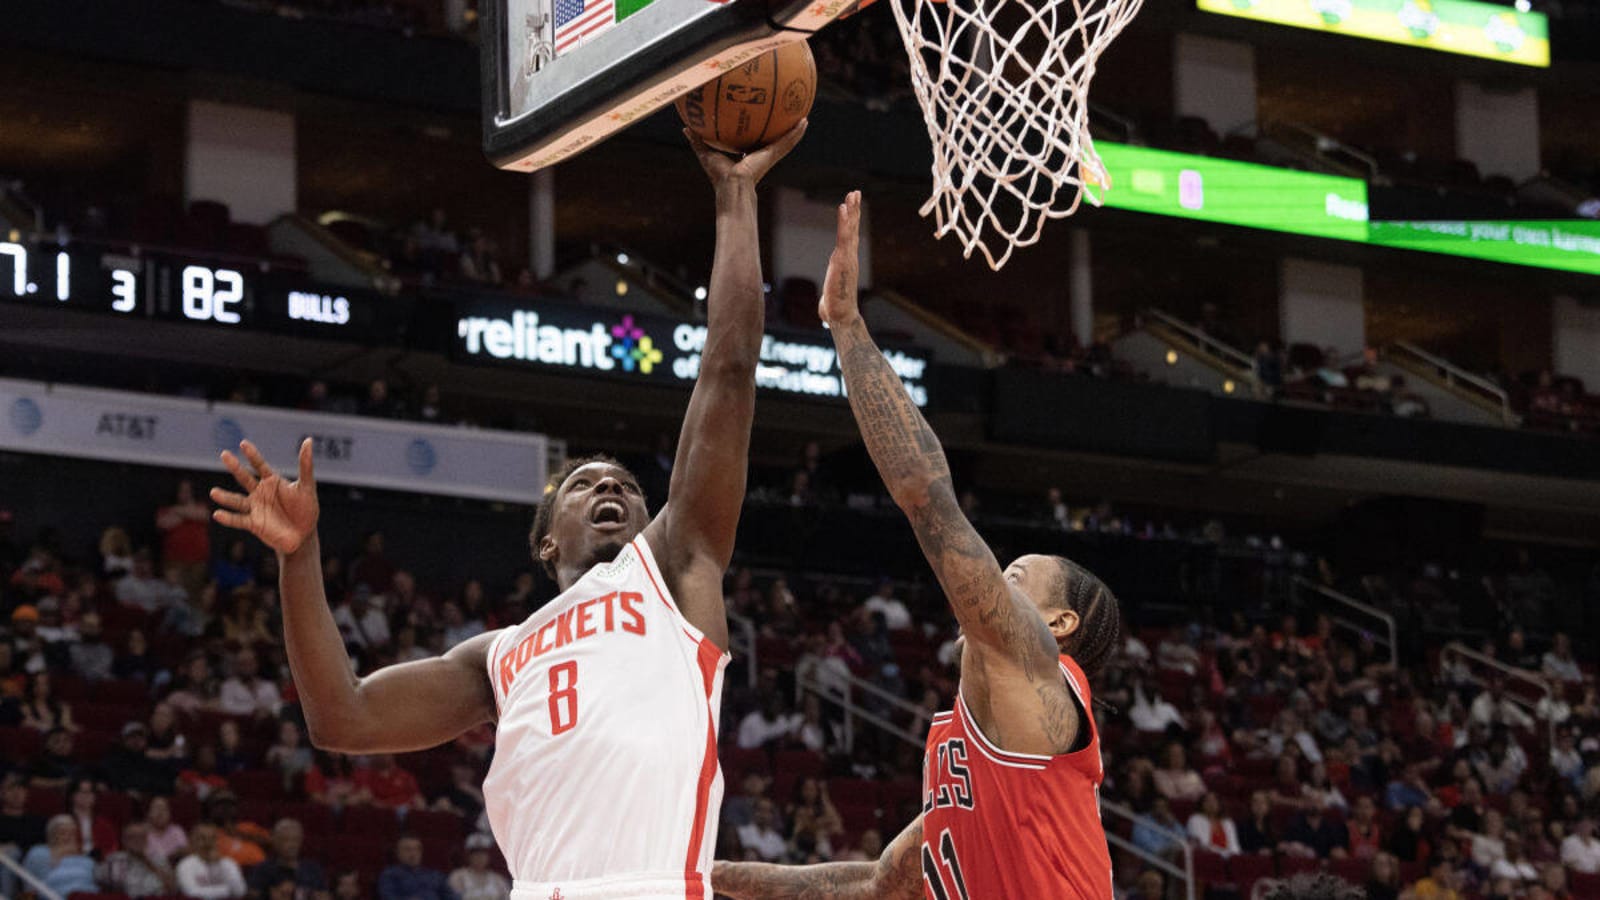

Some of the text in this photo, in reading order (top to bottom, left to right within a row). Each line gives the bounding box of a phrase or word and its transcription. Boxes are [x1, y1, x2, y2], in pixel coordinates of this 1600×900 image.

[111, 269, 136, 312] 3
[182, 265, 244, 324] 82
[288, 291, 351, 325] BULLS
[96, 412, 158, 441] AT&T
[499, 590, 647, 698] ROCKETS
[548, 659, 578, 737] 8
[921, 827, 970, 900] 11
